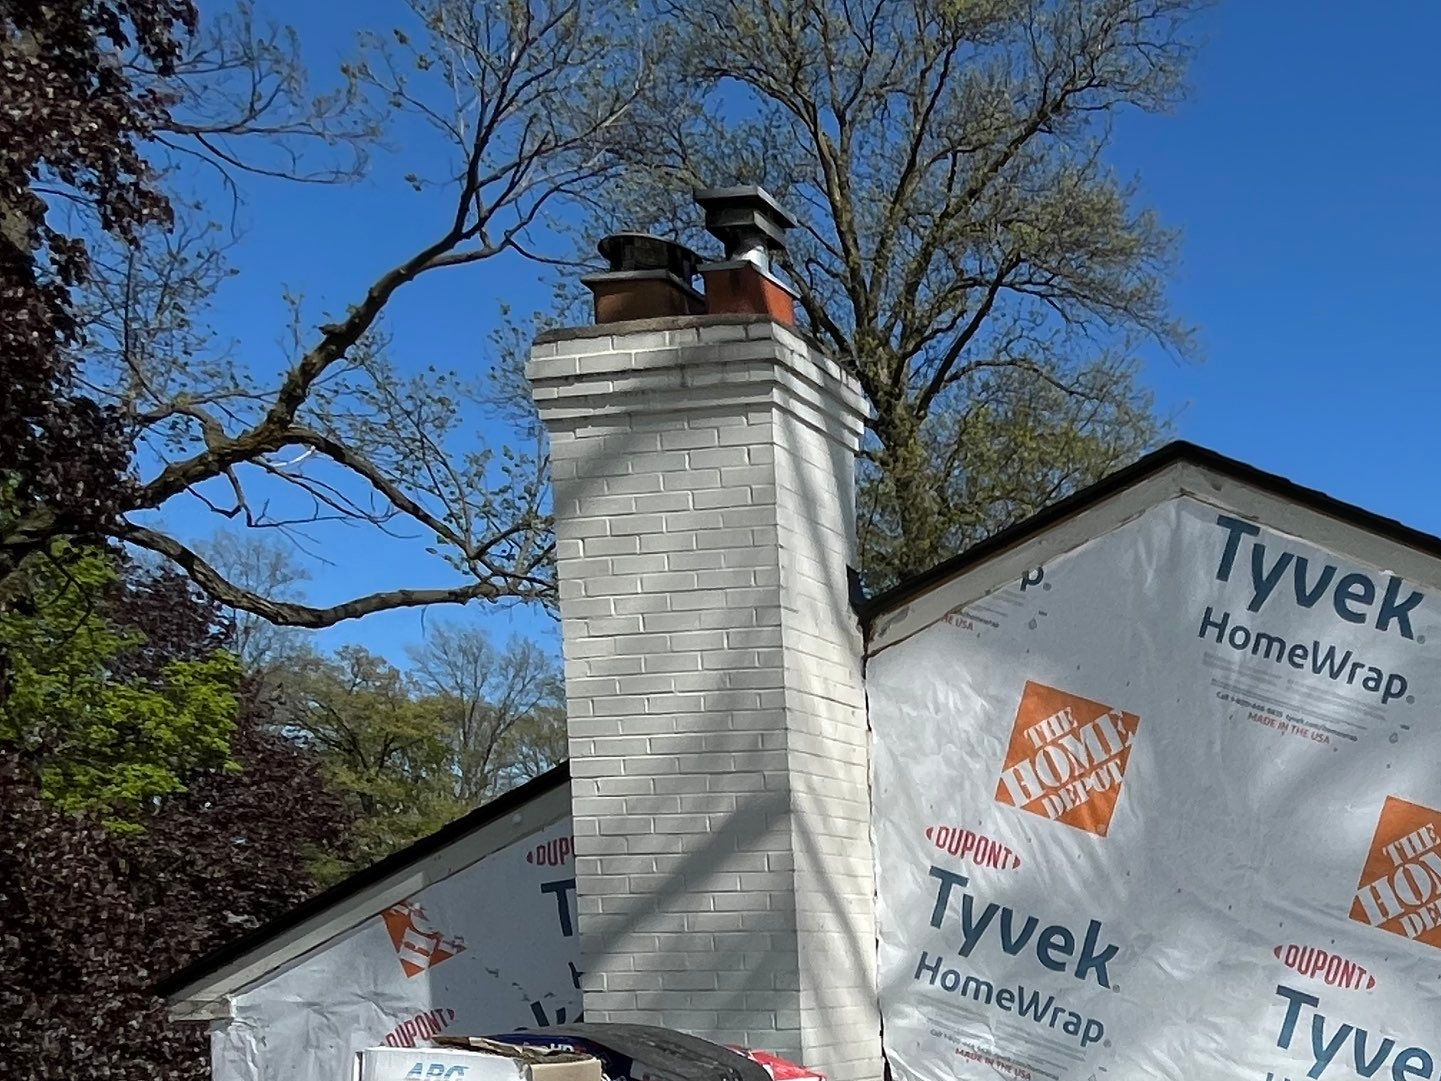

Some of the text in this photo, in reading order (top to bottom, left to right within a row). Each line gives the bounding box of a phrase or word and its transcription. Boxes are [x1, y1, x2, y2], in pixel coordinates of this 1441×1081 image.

[1216, 514, 1425, 641] Tyvek
[954, 618, 975, 631] USA
[1198, 606, 1409, 704] HomeWrap
[1024, 706, 1078, 749] THE
[1247, 711, 1330, 744] MADE IN THE USA
[1001, 710, 1132, 807] HOME
[1041, 759, 1123, 821] DEPOT
[536, 836, 575, 866] DUP
[935, 826, 1013, 869] DUPONT
[1382, 823, 1441, 866] THE
[928, 865, 1120, 990] Tyvek
[1284, 944, 1367, 990] DUPONT
[913, 951, 1105, 1047] HomeWrap
[954, 1046, 1032, 1080] MADE IN THE USA
